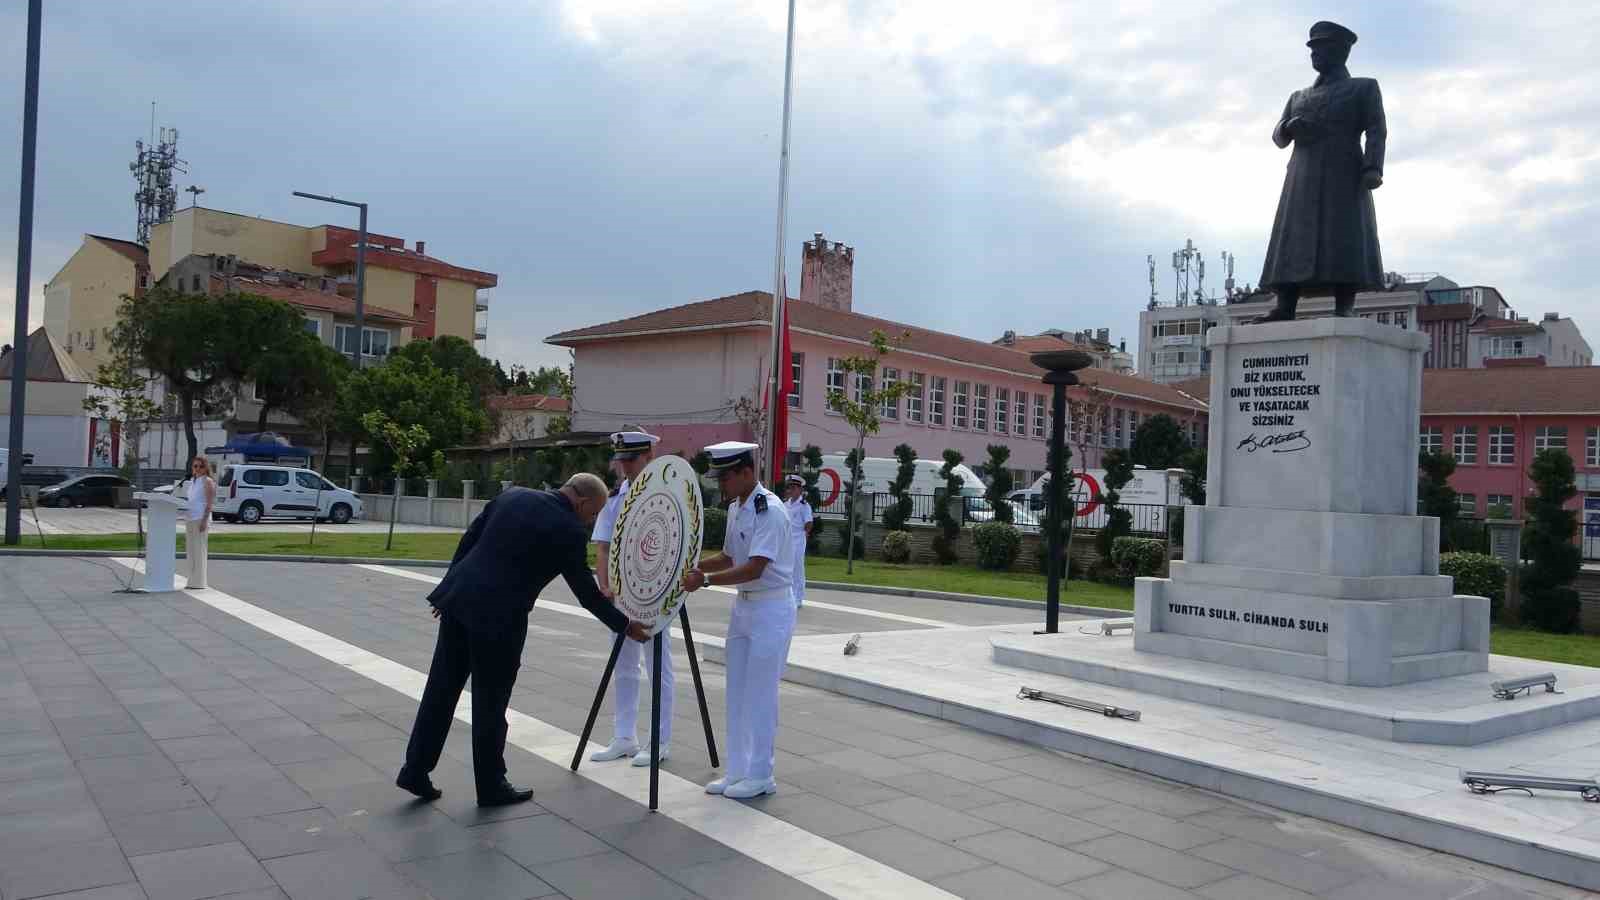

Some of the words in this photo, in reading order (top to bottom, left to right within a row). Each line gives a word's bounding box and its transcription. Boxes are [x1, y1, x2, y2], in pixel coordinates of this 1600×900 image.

[1242, 353, 1309, 368] CUMHURİYETİ
[1244, 370, 1260, 383] BİZ
[1230, 387, 1251, 398] ONU
[1253, 384, 1320, 397] YÜKSELTECEK
[1239, 402, 1251, 412] VE
[1253, 400, 1310, 412] YAŞATACAK
[1252, 413, 1294, 426] SİZSİNİZ
[1168, 603, 1206, 617] YURTTA
[1243, 611, 1295, 629] CİHANDA
[1299, 619, 1329, 633] SULH
